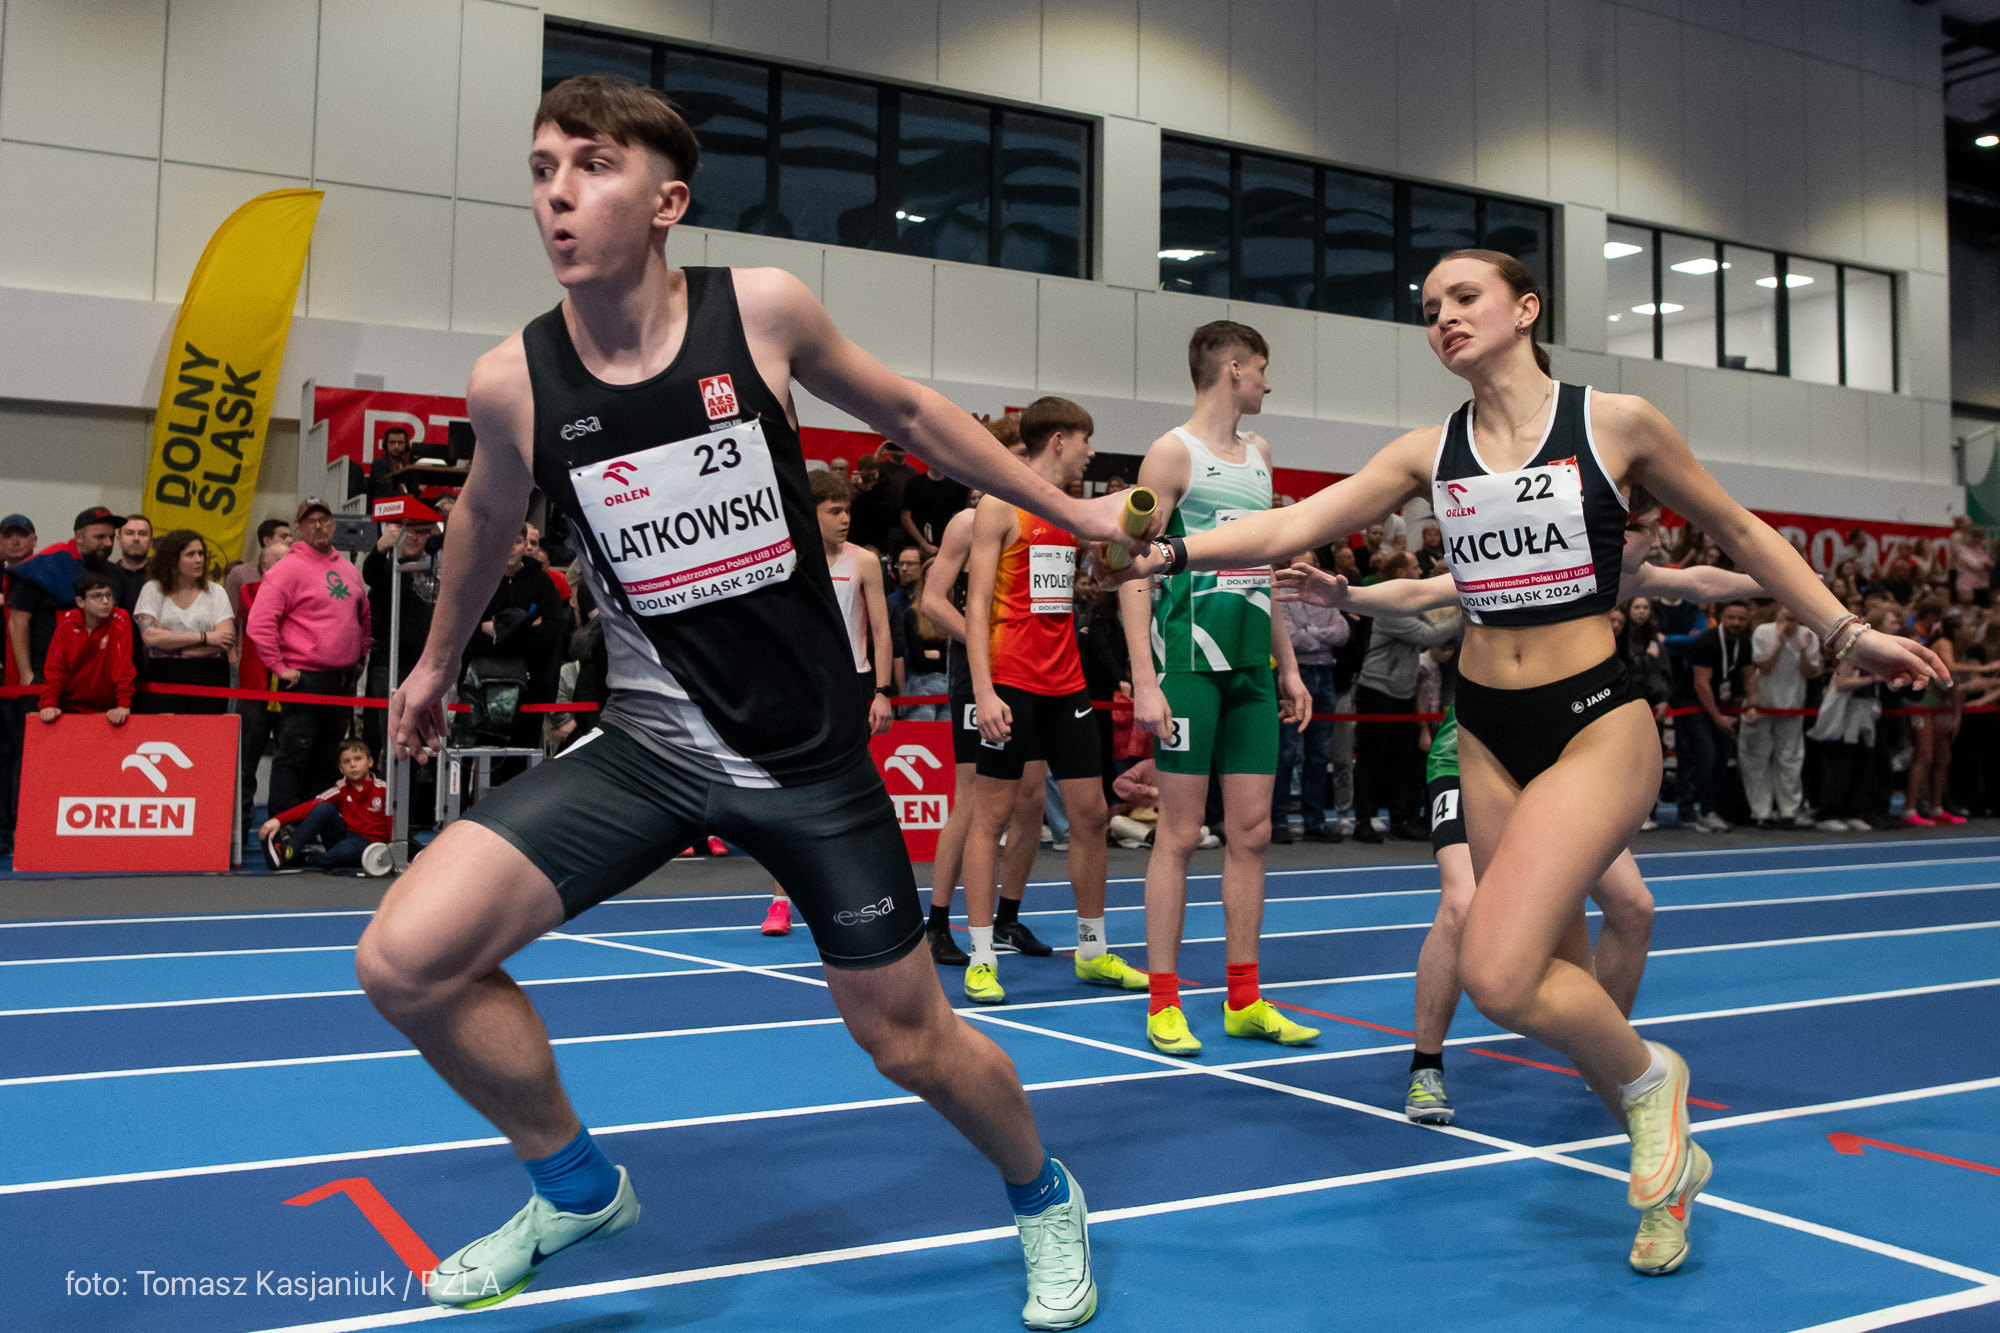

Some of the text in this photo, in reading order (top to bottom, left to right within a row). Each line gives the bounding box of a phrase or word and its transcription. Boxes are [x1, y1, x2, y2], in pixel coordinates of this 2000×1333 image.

[708, 394, 734, 408] AZS
[710, 403, 735, 417] AWF
[155, 341, 219, 507] DOLNY
[191, 361, 261, 516] ŚLĄSK
[694, 438, 742, 476] 23
[604, 487, 650, 507] ORLEN
[1515, 473, 1554, 503] 22
[599, 487, 779, 563] LATKOWSKI
[1446, 507, 1476, 518] ORLEN
[1448, 522, 1570, 565] KICUŁA
[637, 580, 671, 592] Halowe
[671, 565, 726, 585] Mistrzostwa
[727, 555, 754, 572] Polski
[754, 550, 770, 561] U18
[775, 541, 791, 554] U20
[1486, 579, 1530, 590] Mistrzostwa
[1531, 574, 1554, 584] Polski
[1554, 571, 1569, 580] U18
[1574, 567, 1590, 577] U20
[636, 562, 785, 611] DOLNY ŚLĄSK 2024
[1462, 584, 1581, 607] DOLNY ŚLĄSK 2024
[1586, 688, 1611, 707] JAKO
[65, 803, 186, 830] ORLEN
[1435, 793, 1449, 821] 4
